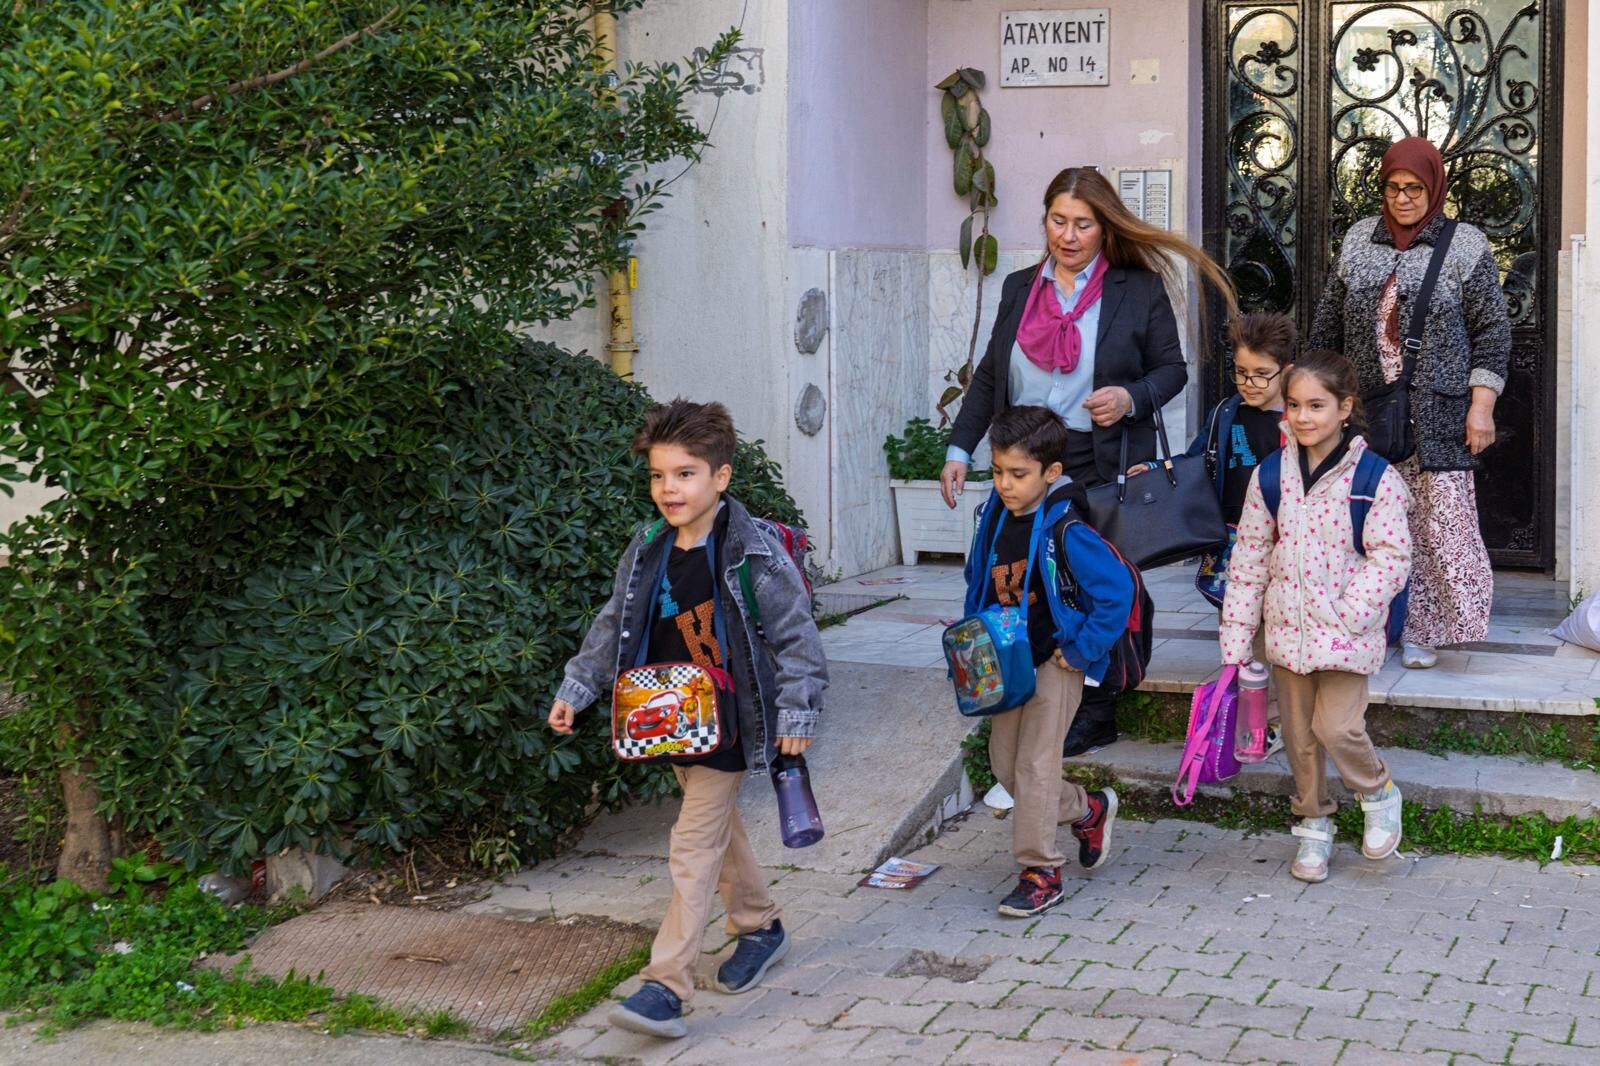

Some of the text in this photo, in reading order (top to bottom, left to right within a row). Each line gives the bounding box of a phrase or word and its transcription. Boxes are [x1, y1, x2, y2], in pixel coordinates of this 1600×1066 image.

[1003, 21, 1106, 45] ATAYKENT
[1010, 55, 1096, 74] AP. NO 14
